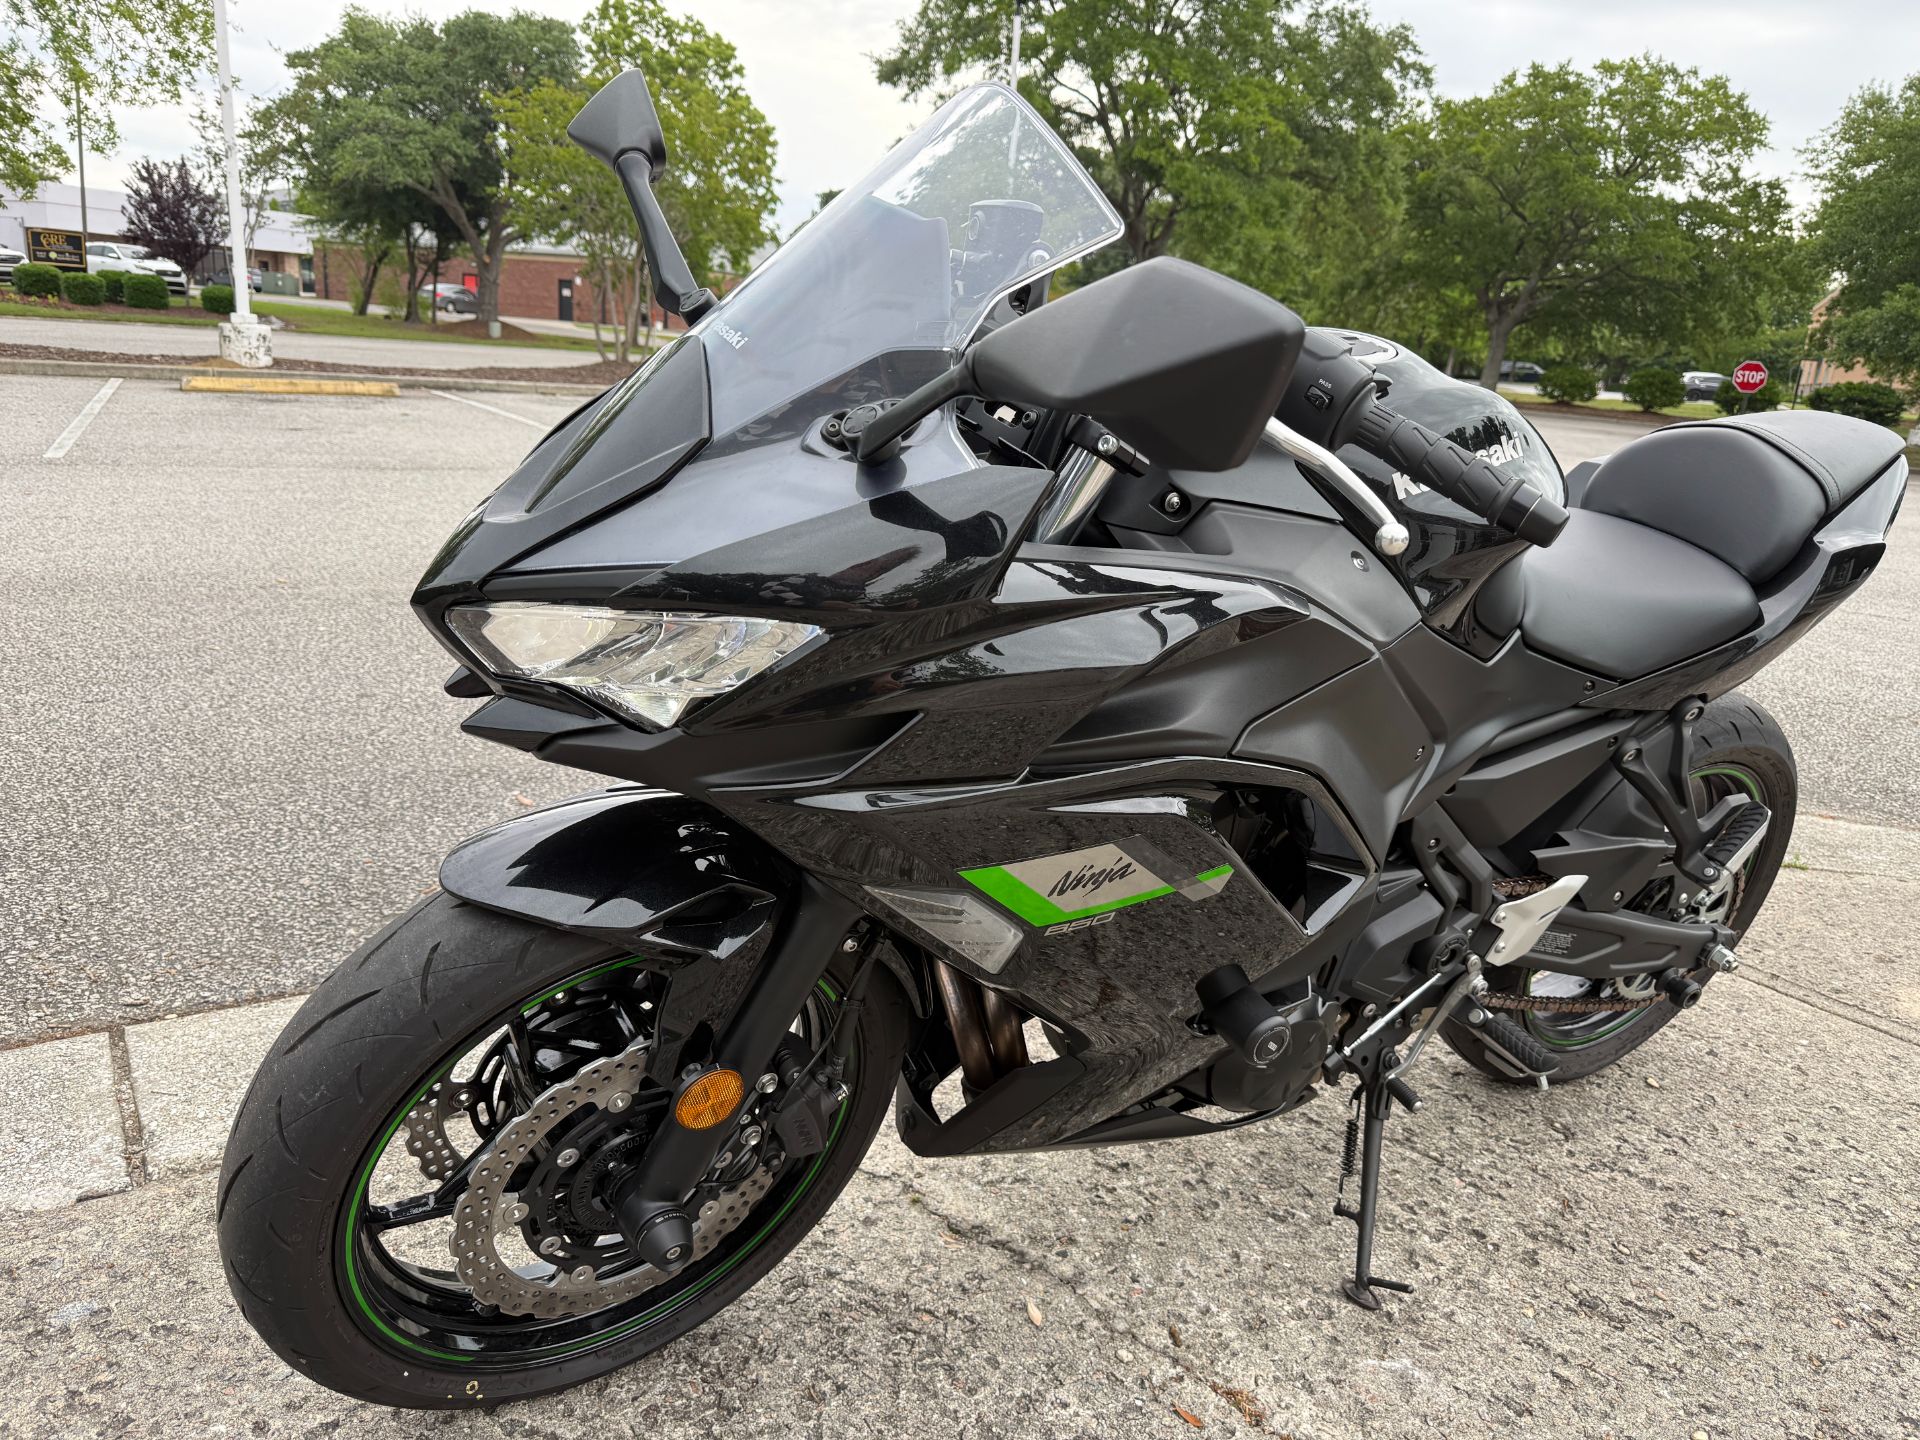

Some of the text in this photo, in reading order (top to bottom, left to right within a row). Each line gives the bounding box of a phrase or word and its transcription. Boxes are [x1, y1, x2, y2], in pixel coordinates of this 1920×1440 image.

[1735, 370, 1765, 384] STOP
[1047, 856, 1136, 898] Ninja
[1044, 911, 1116, 937] 650
